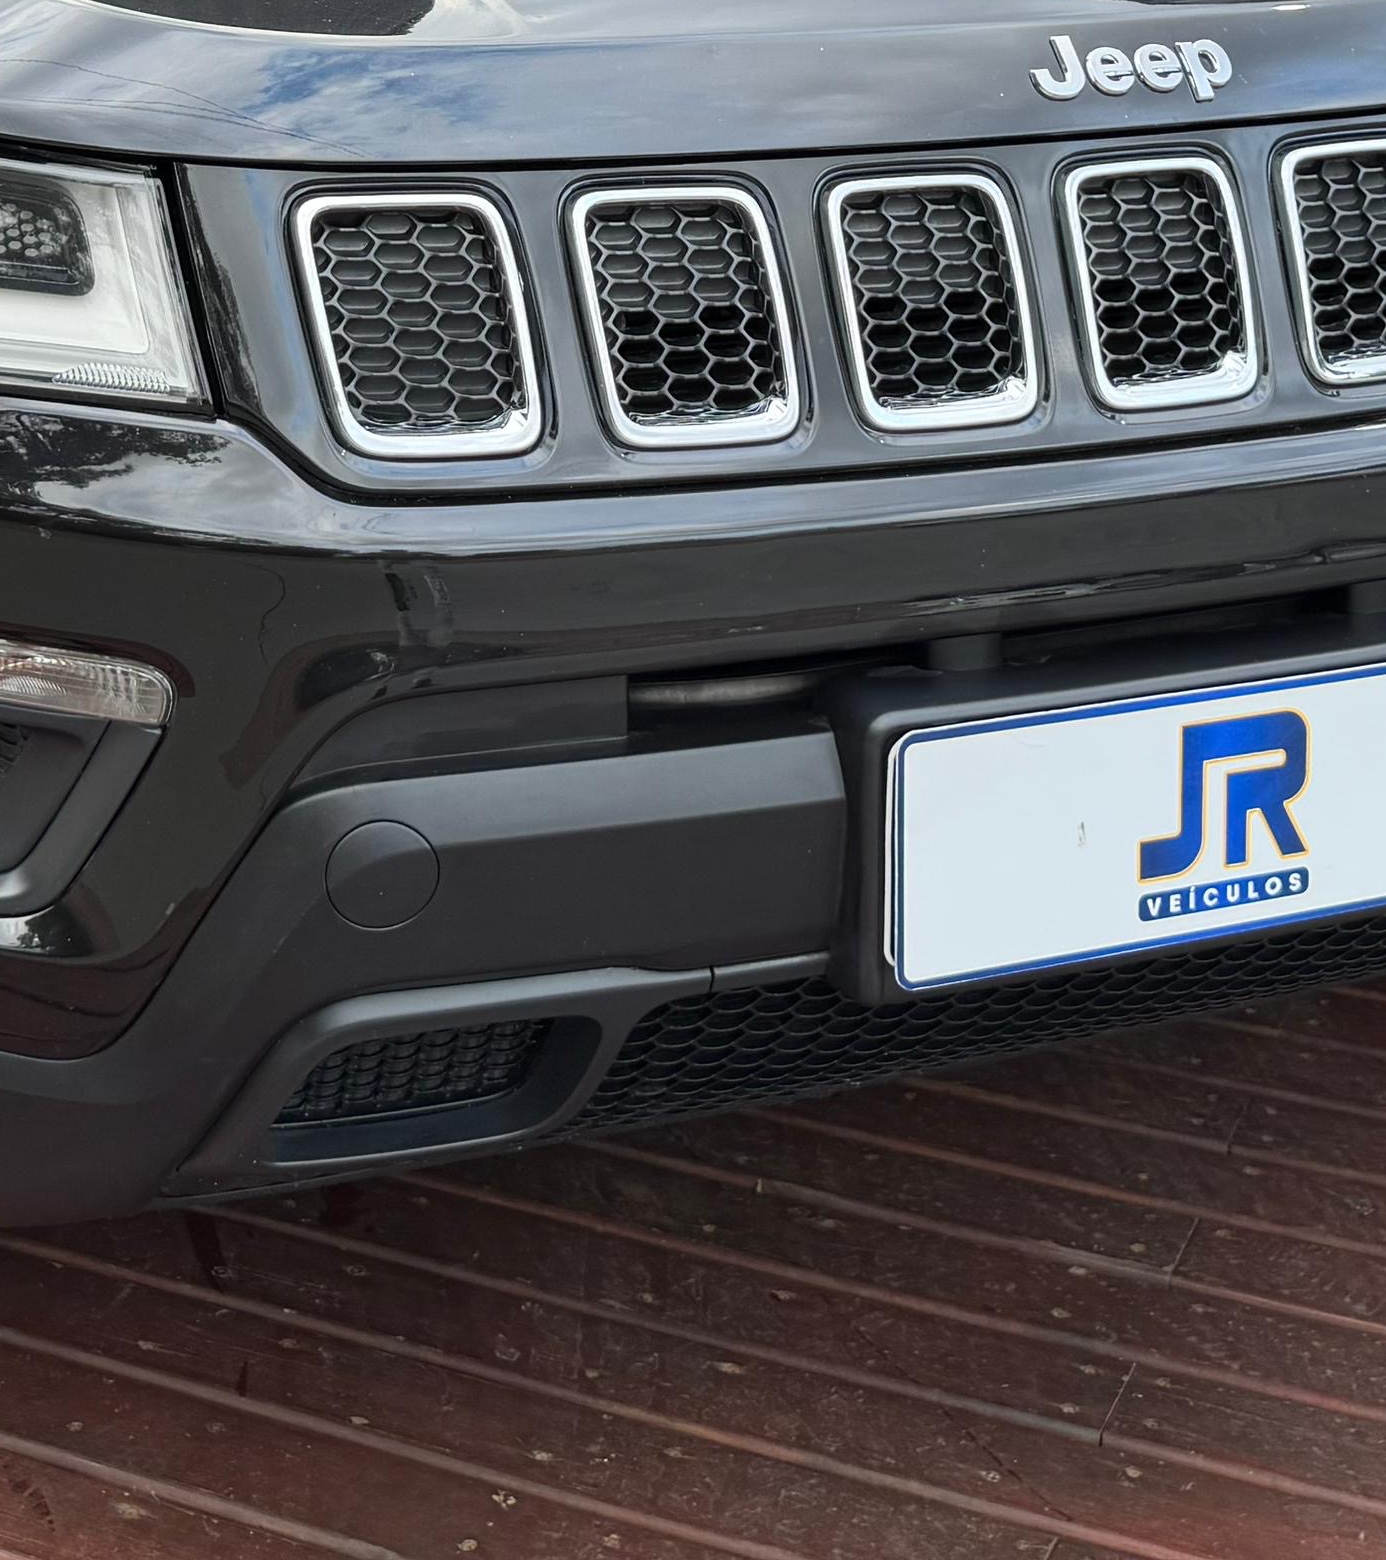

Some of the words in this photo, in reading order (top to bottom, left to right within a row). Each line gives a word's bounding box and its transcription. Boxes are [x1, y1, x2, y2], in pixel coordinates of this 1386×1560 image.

[1029, 35, 1233, 103] Jeep
[1137, 707, 1311, 882] JR
[1145, 872, 1303, 917] VEÍCULOS
